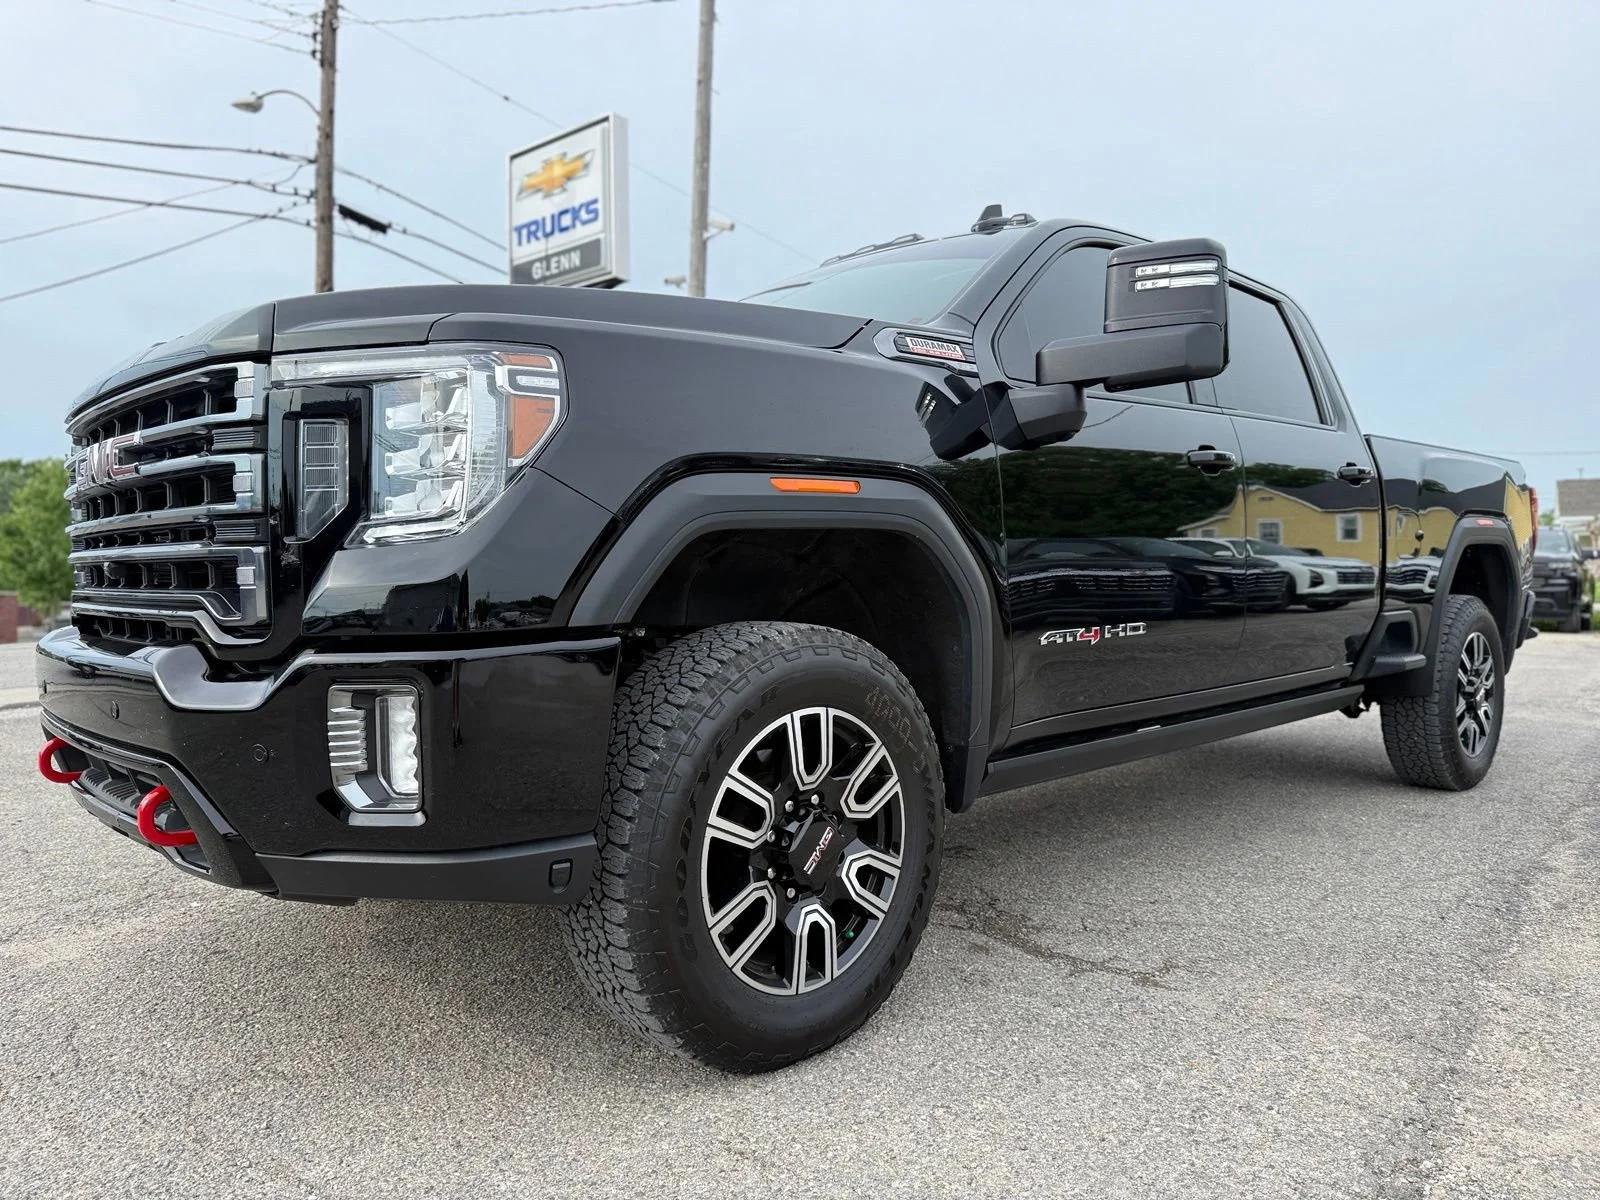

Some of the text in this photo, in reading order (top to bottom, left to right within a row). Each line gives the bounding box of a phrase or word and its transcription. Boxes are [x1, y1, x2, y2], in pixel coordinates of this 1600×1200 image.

[513, 198, 599, 247] TRUCKS
[531, 250, 581, 279] GLENN
[909, 338, 960, 354] DURAMAX
[1039, 622, 1146, 645] AT4 HD
[803, 826, 834, 875] GMC
